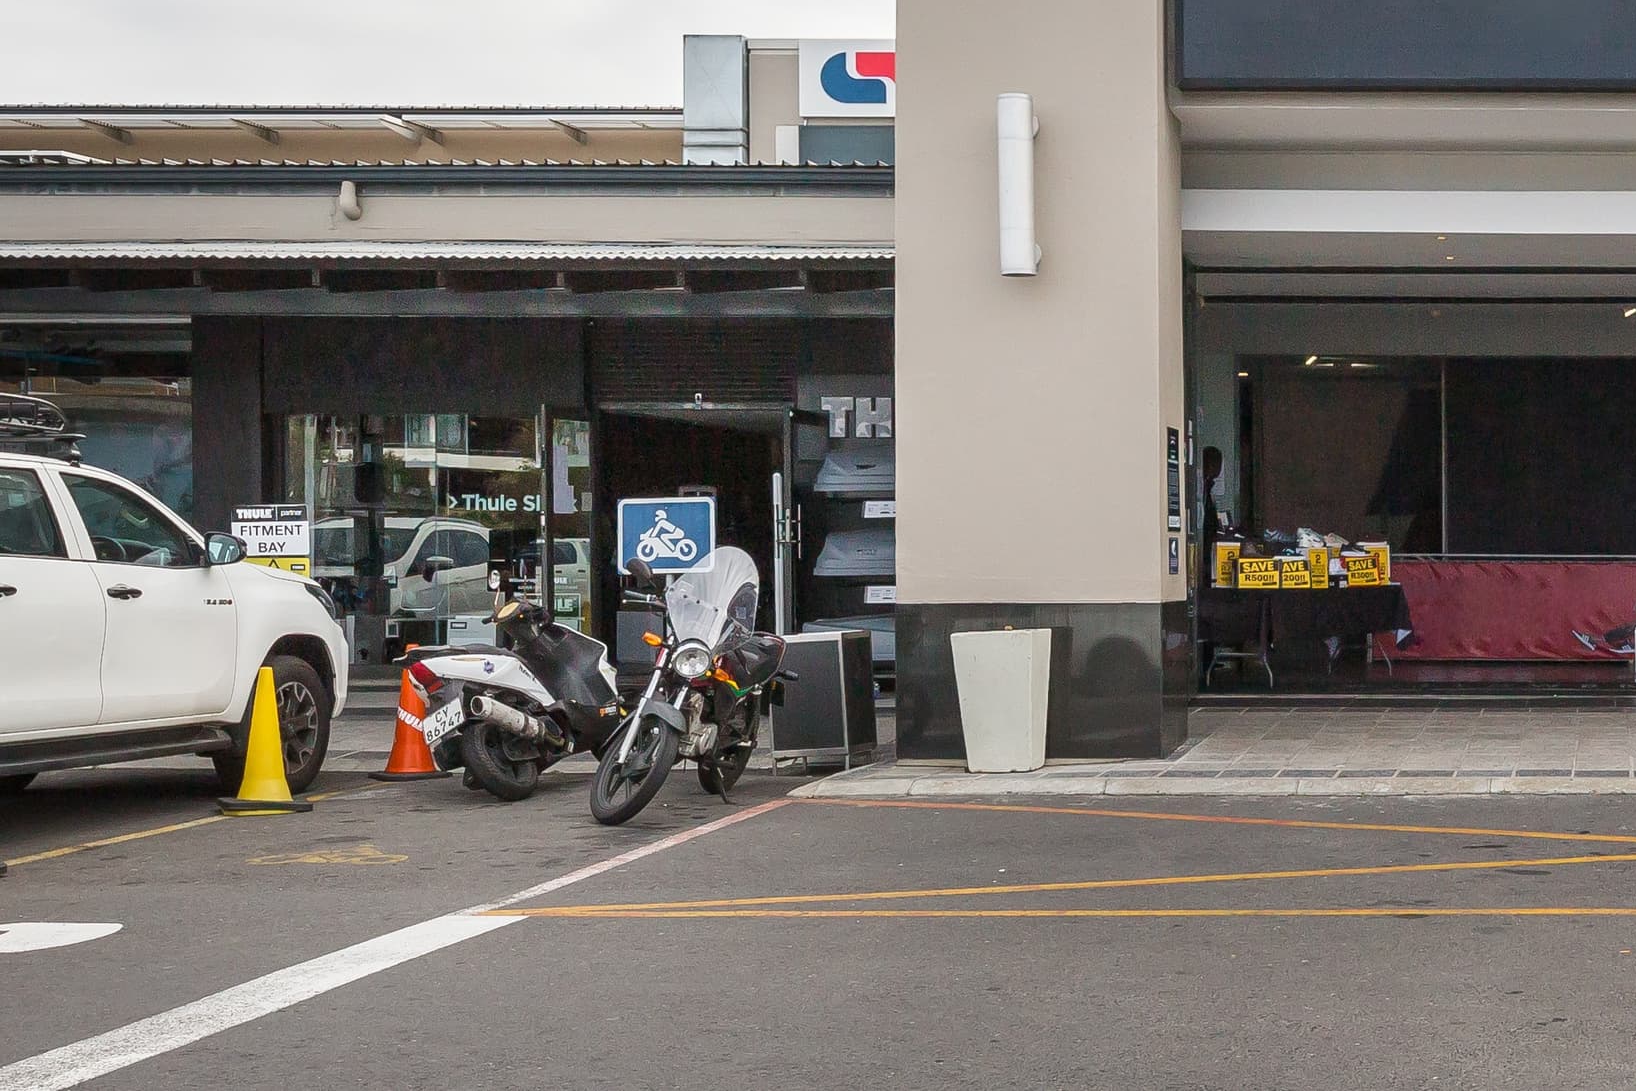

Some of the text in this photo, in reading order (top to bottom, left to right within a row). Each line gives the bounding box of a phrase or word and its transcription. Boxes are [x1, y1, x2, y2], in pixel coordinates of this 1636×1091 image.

[462, 494, 517, 511] Thule
[236, 508, 273, 519] THULE
[240, 524, 303, 536] FITMENT
[258, 541, 286, 553] BAY
[1242, 561, 1275, 573] SAVE
[1282, 561, 1305, 572] AVE
[1348, 559, 1374, 571] SAVE
[1245, 574, 1275, 582] R500!!
[1283, 574, 1306, 582] 200!!
[434, 706, 449, 723] CY
[426, 711, 461, 742] 86747
